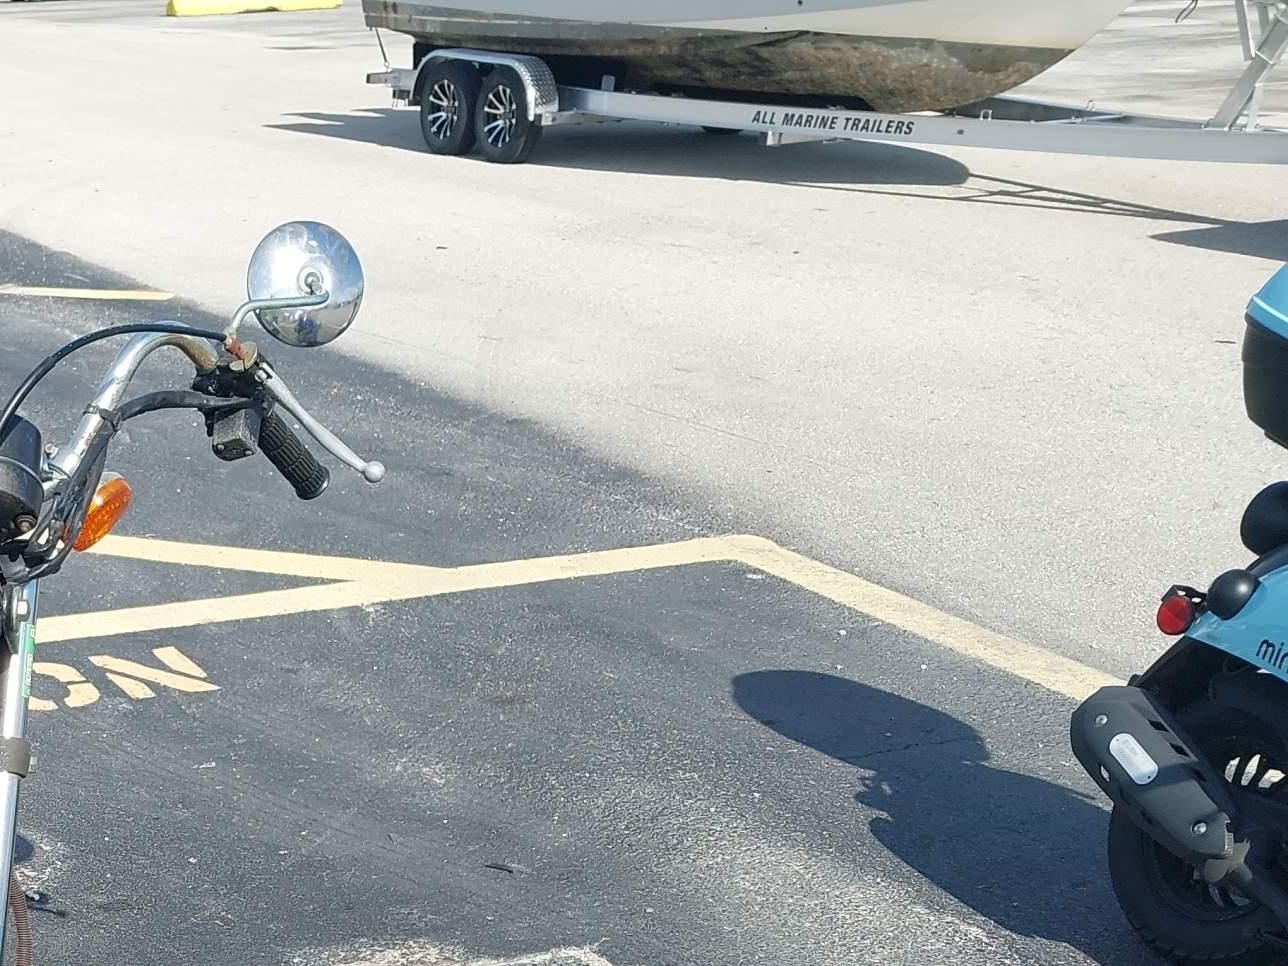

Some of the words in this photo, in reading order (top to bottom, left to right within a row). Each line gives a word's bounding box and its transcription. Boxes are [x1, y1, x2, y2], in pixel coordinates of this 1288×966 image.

[752, 111, 776, 125] ALL
[781, 113, 839, 129] MARINE
[843, 117, 915, 135] TRAILERS
[28, 646, 222, 711] NO
